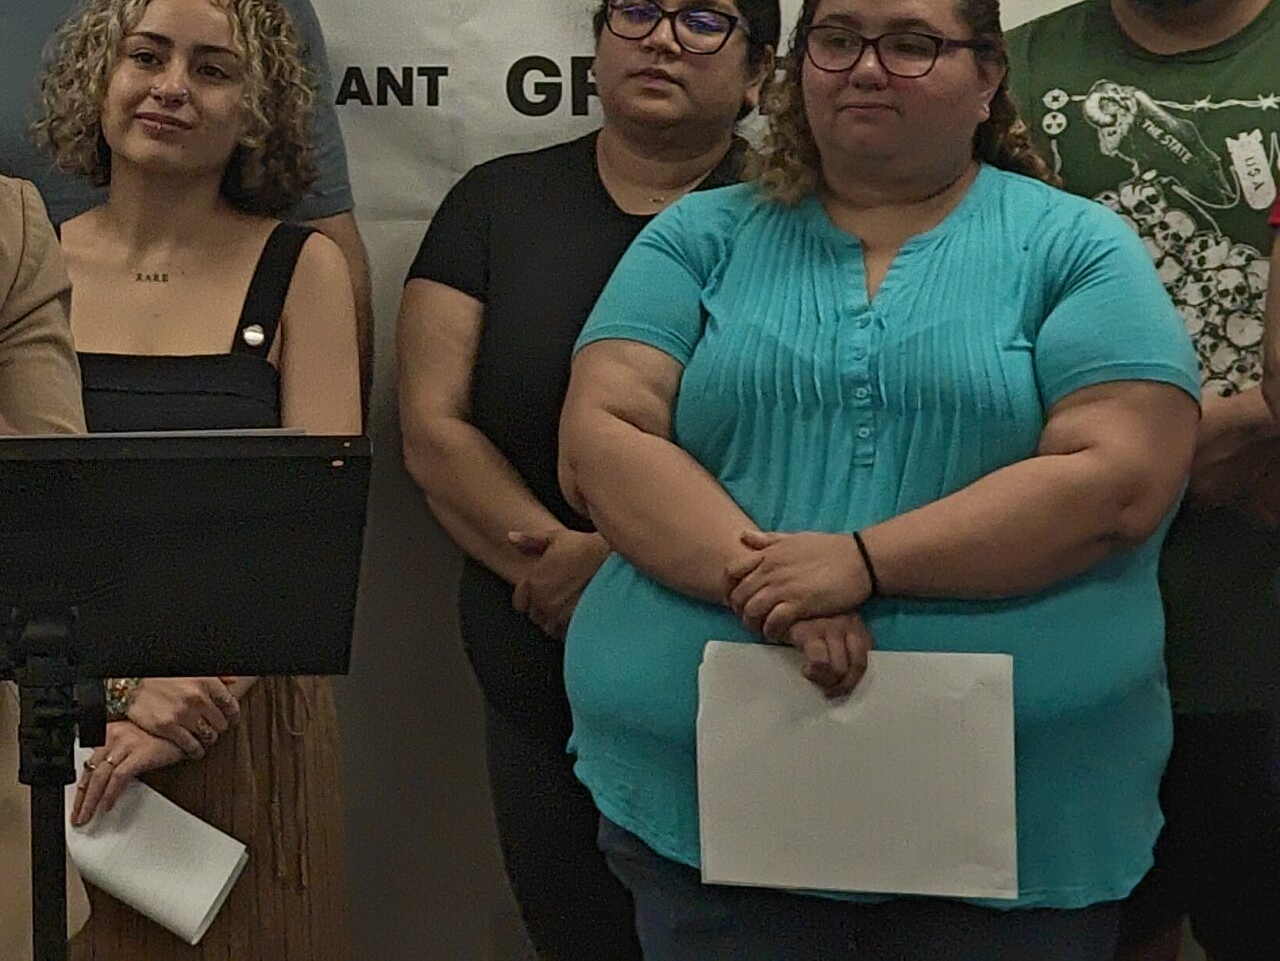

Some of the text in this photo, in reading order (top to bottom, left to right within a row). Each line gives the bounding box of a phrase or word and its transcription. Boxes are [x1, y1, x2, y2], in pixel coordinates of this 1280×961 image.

[335, 66, 449, 107] ANT
[1141, 118, 1194, 165] THE STATE
[1244, 156, 1265, 193] USA
